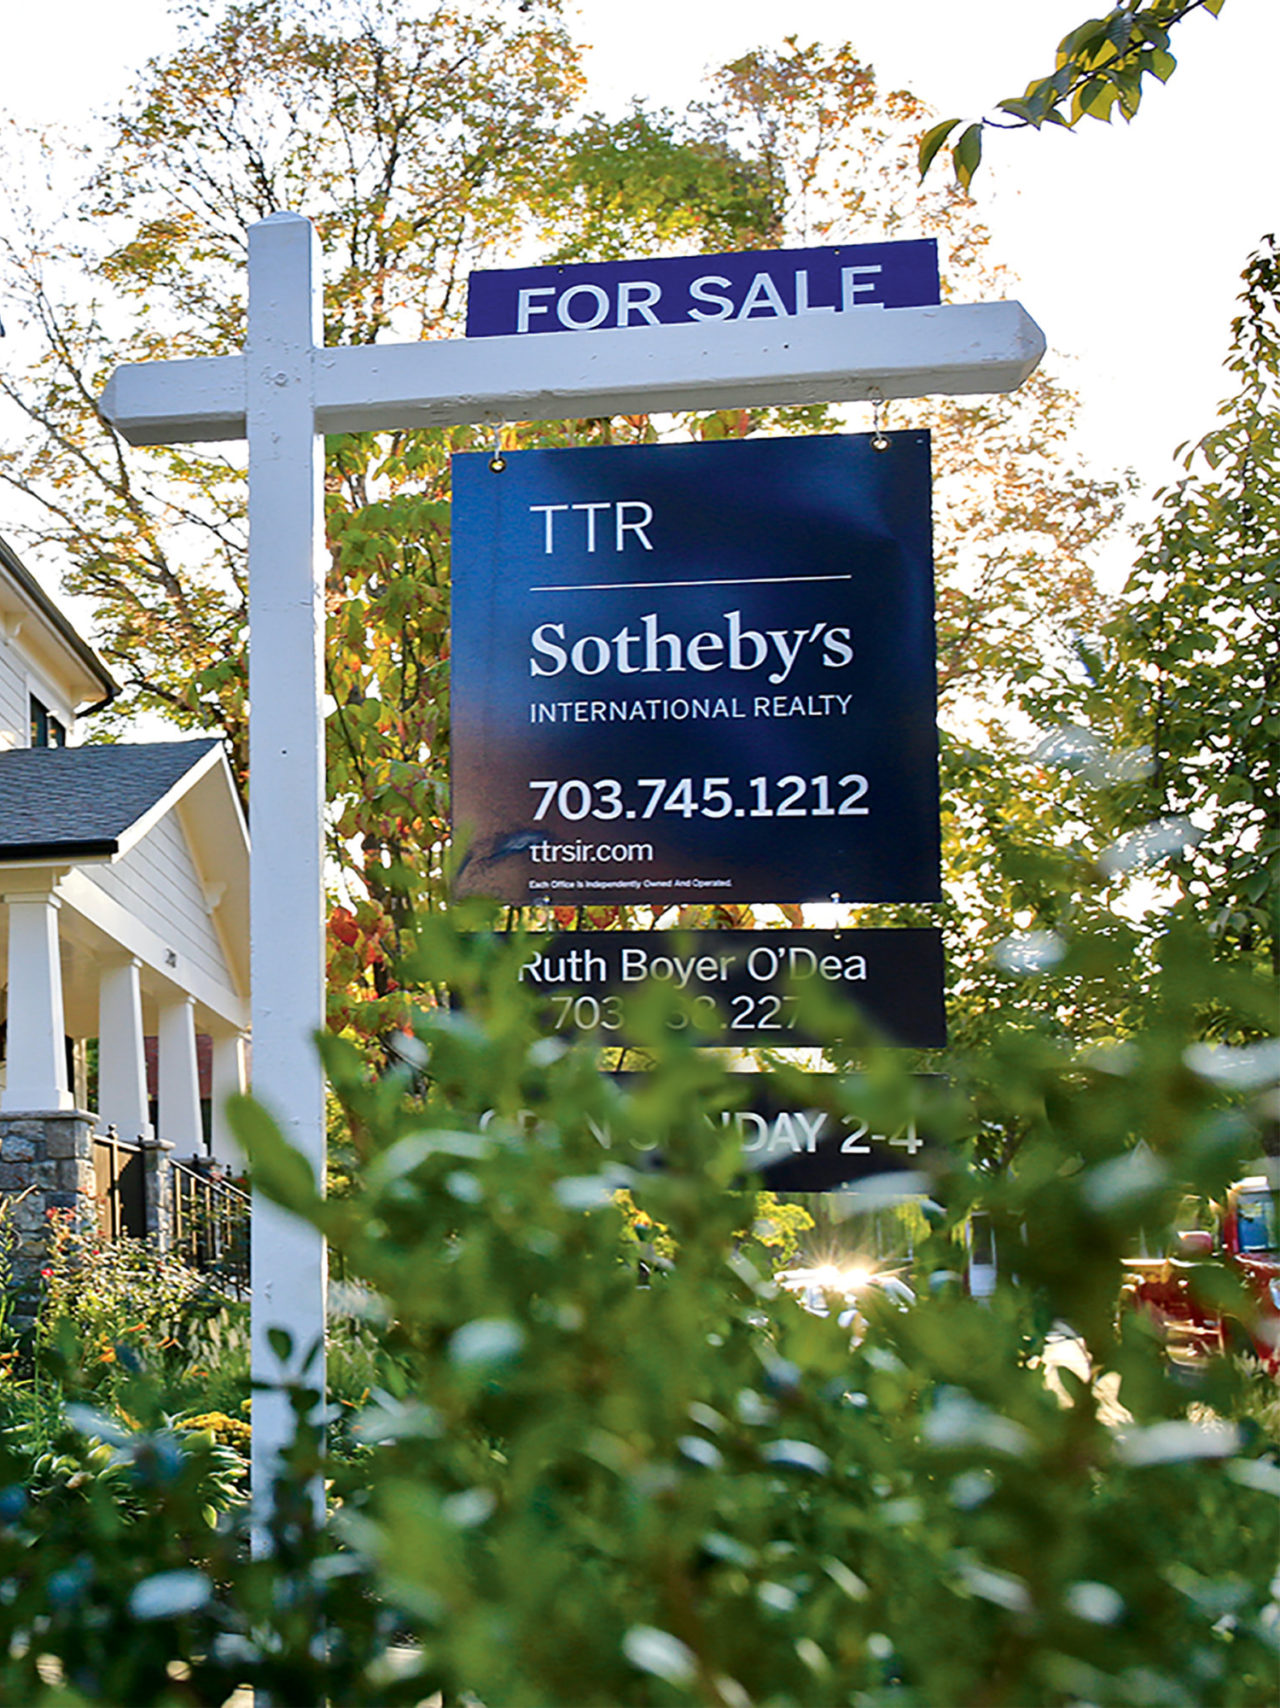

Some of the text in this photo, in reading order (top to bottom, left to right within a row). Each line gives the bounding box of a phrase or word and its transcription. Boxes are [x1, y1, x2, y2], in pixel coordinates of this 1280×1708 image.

[516, 263, 885, 333] FOR SALE
[529, 501, 654, 554] TTR
[529, 610, 854, 684] Sotheby's
[529, 694, 853, 724] INTERNATIONAL REALTY
[529, 774, 870, 821] 703.745.1212
[529, 839, 654, 863] ttrsir.com
[518, 947, 868, 990] Ruth Boyer O'Dea
[840, 1114, 924, 1155] 2-4
